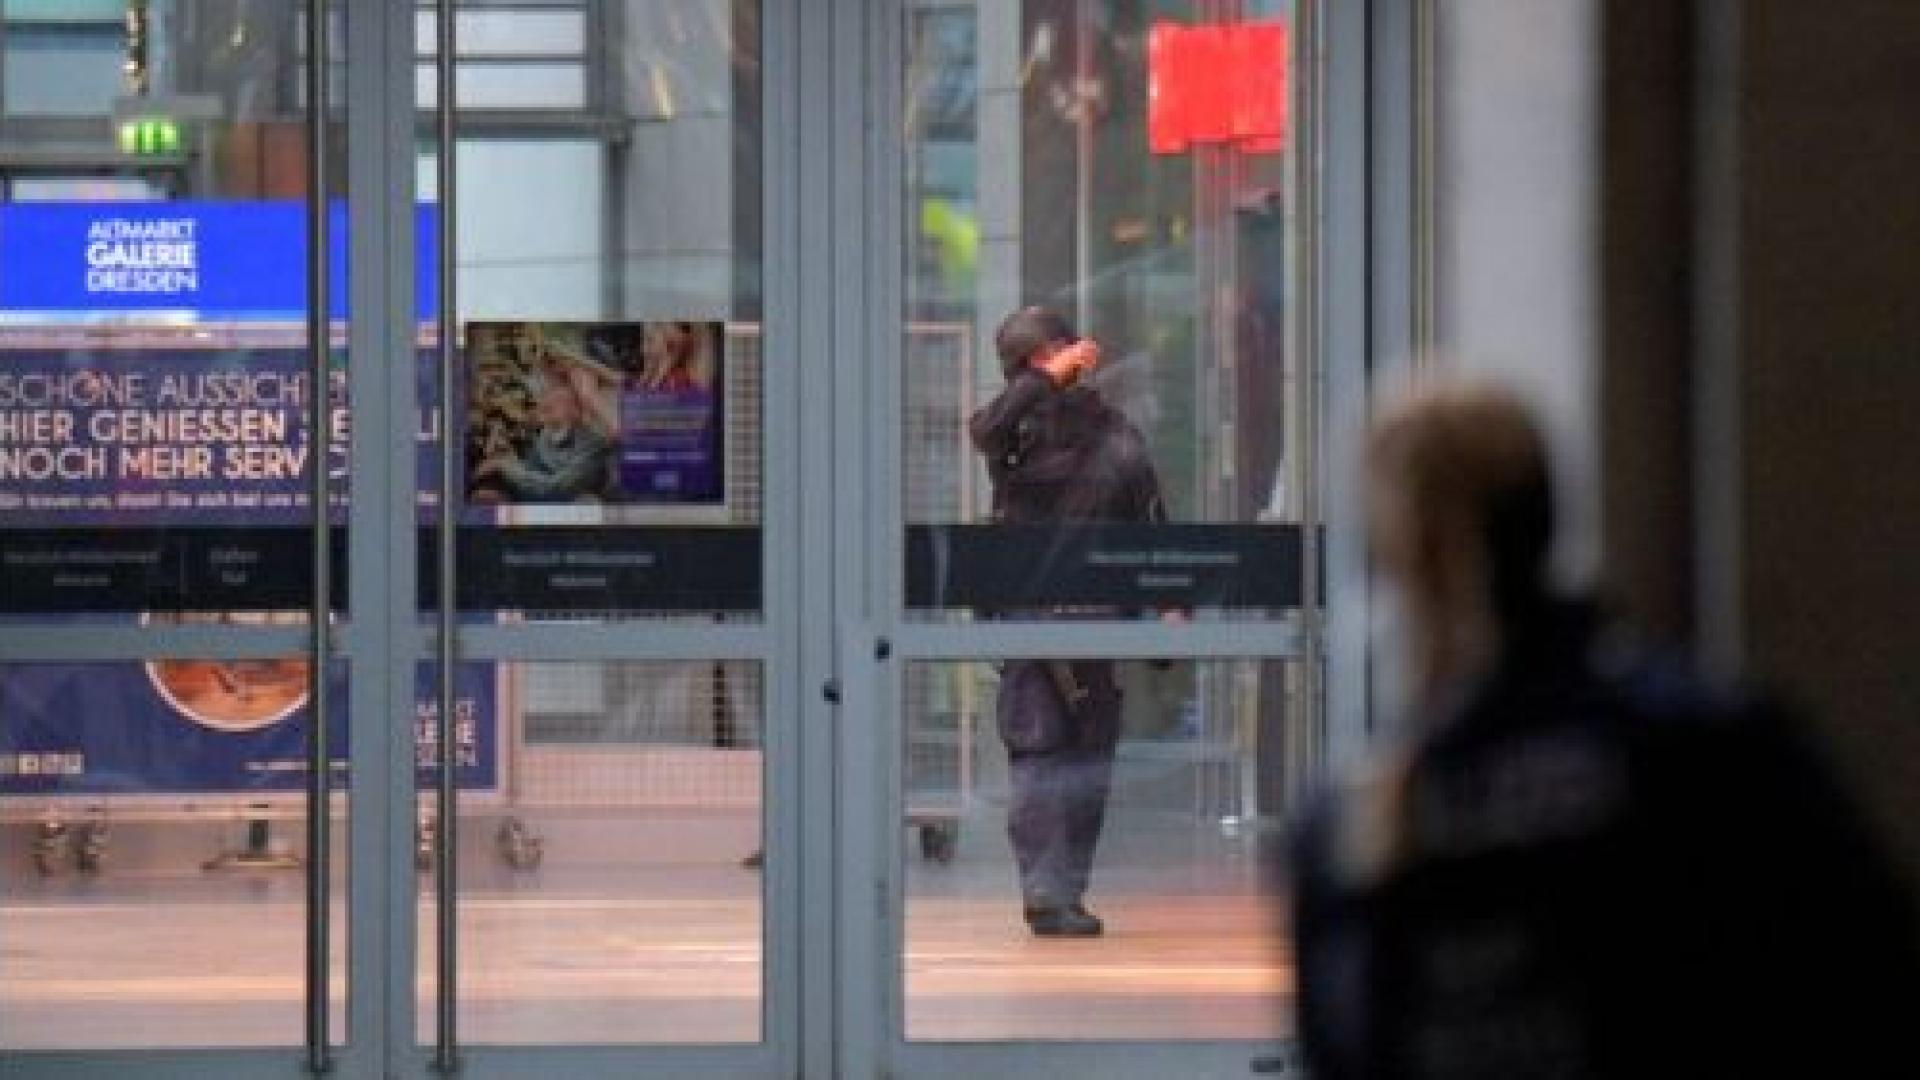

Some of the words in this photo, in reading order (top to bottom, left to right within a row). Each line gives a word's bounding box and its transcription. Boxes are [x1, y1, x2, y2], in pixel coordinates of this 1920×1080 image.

[87, 219, 196, 239] ALTMARKT
[86, 241, 197, 267] GALERIE
[87, 270, 197, 292] DRESDEN
[0, 409, 73, 441] HIER
[90, 409, 285, 441] GENIESSEN
[0, 447, 105, 480] NOCH
[119, 447, 212, 480] MEHR
